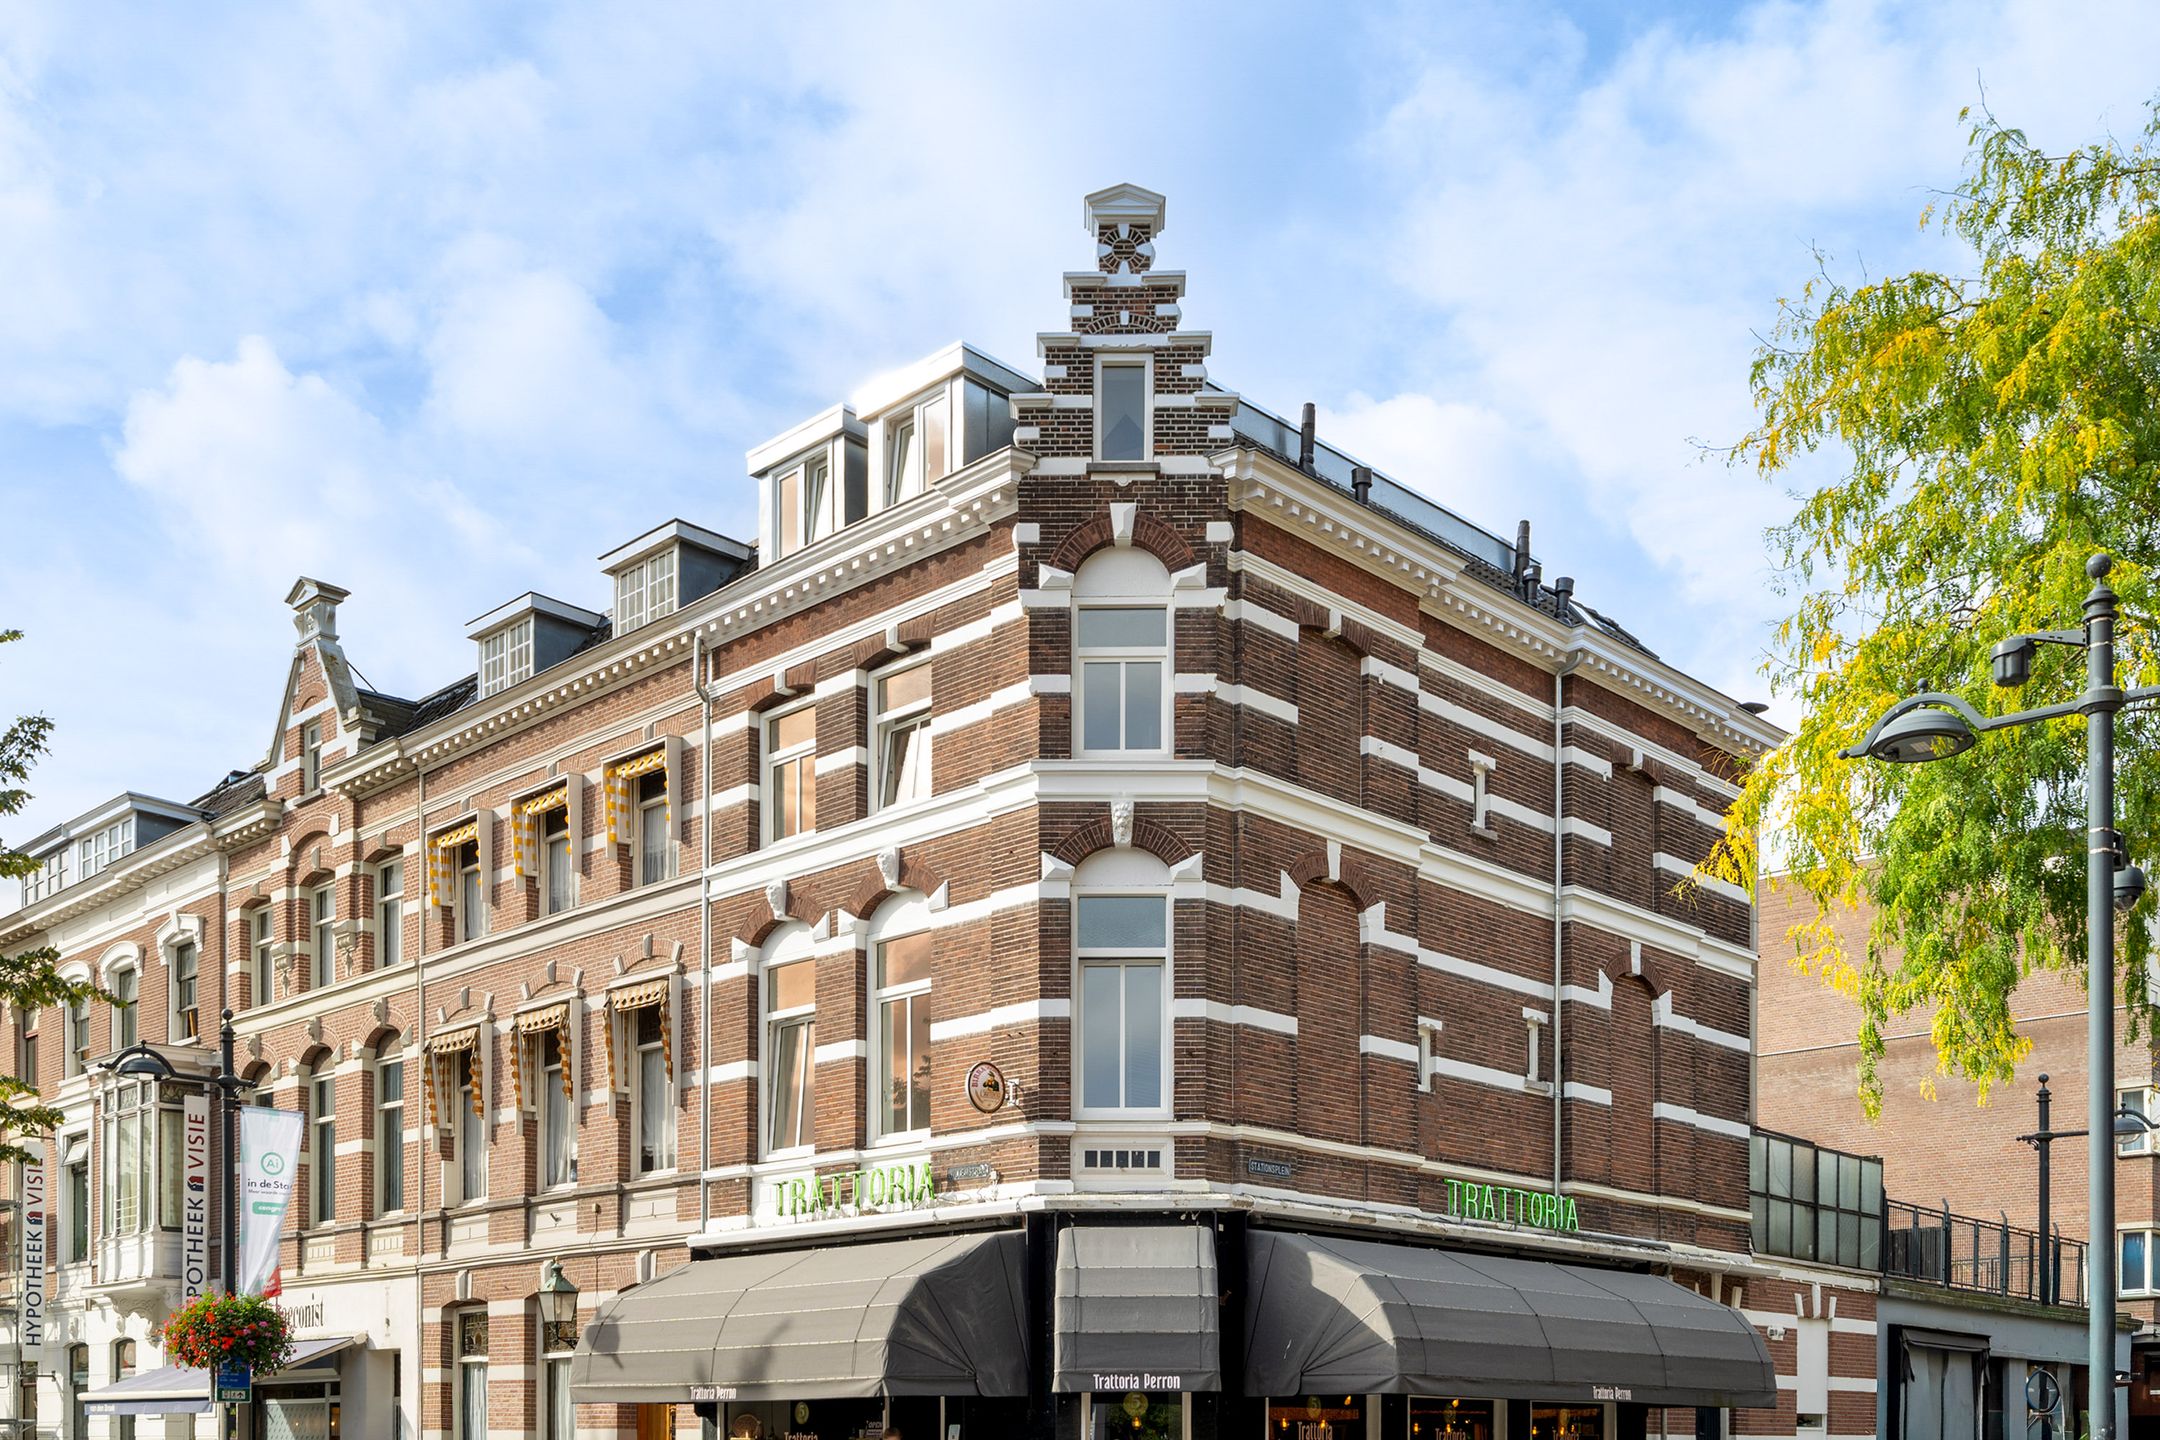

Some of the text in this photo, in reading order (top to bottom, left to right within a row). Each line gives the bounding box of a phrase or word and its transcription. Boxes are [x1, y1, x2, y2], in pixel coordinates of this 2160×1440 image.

[1250, 1160, 1291, 1176] STATIONSPLEIN
[247, 1178, 292, 1190] in de Sta
[772, 1161, 936, 1217] TRATTORIA
[186, 1113, 205, 1297] POTHEEK VISIE
[1444, 1178, 1579, 1232] TRATTORIA
[25, 1230, 43, 1346] HYPOTHEEK
[1093, 1373, 1181, 1390] Trattoria Perron
[690, 1385, 737, 1400] Trattoria Perron
[1592, 1385, 1632, 1401] Trattoria Perron
